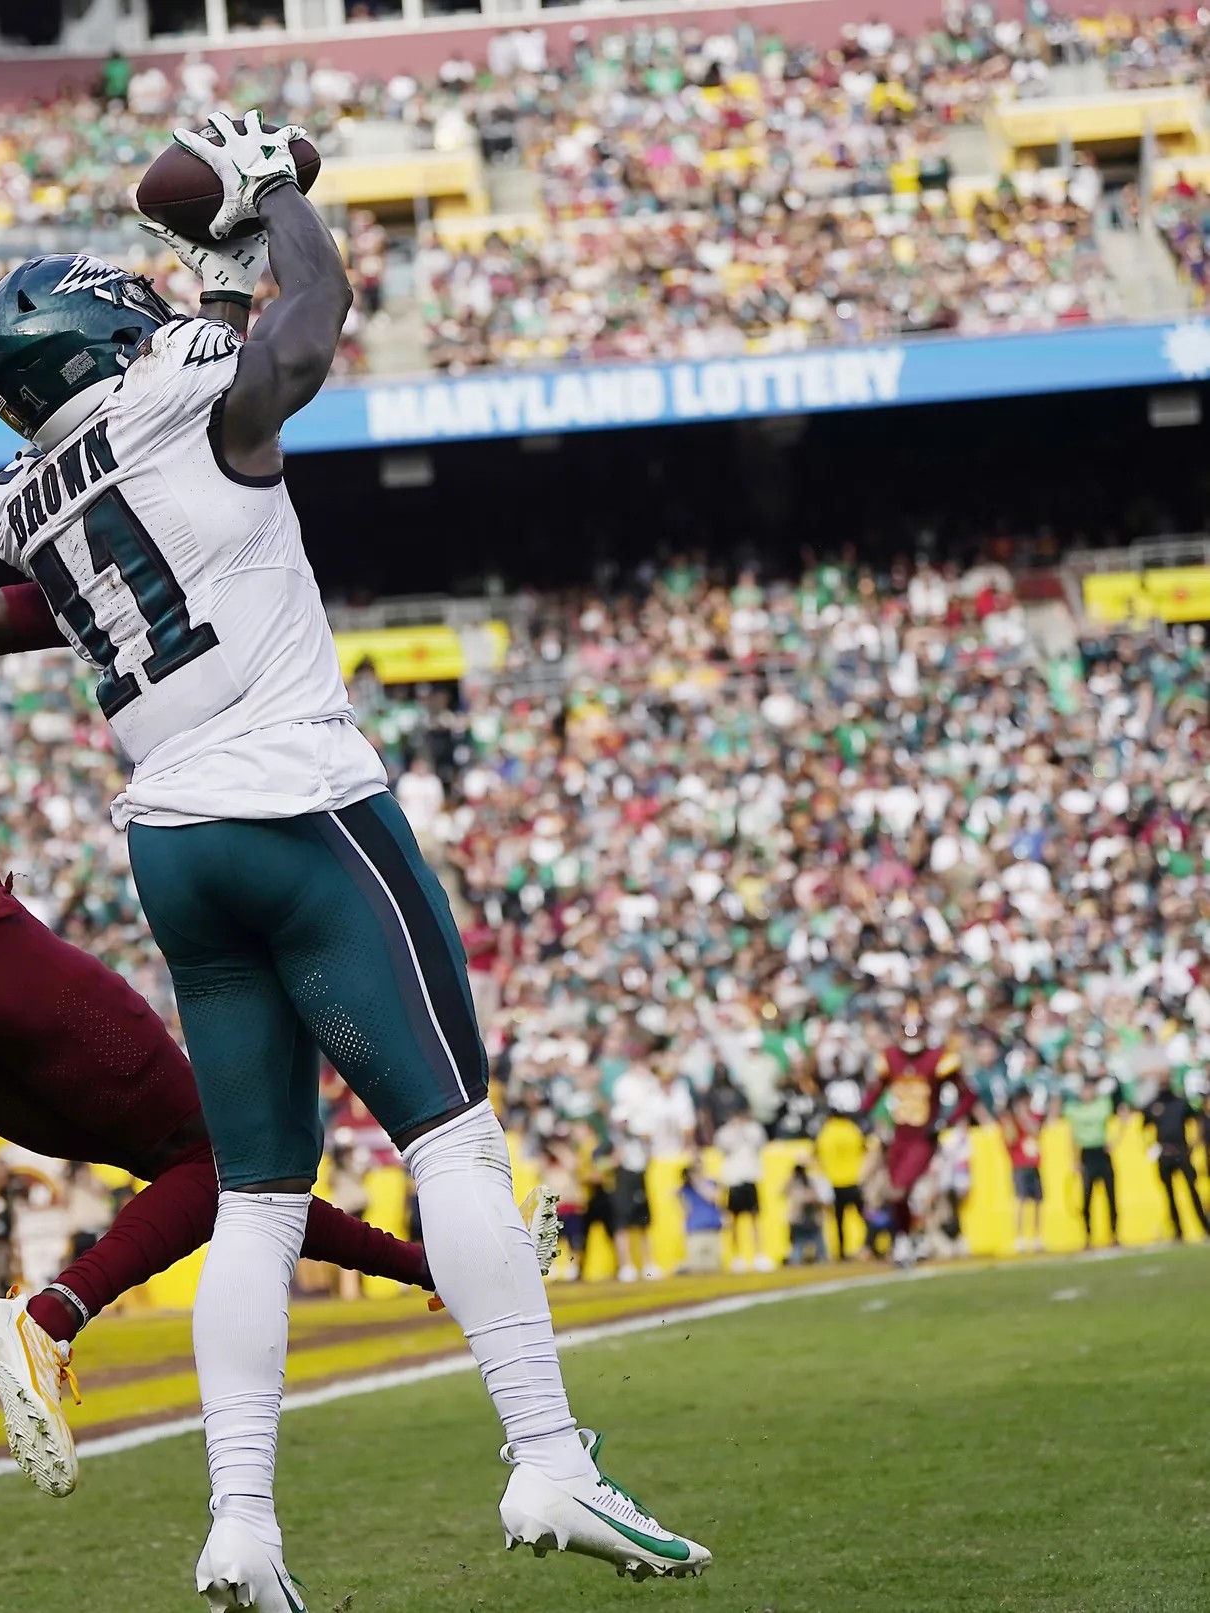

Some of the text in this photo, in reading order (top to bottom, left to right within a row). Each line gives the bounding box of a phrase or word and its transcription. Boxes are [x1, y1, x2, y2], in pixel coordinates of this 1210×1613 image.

[368, 347, 906, 441] MARYLAND LOTTERY
[6, 417, 119, 548] BROWN
[29, 485, 221, 722] 11
